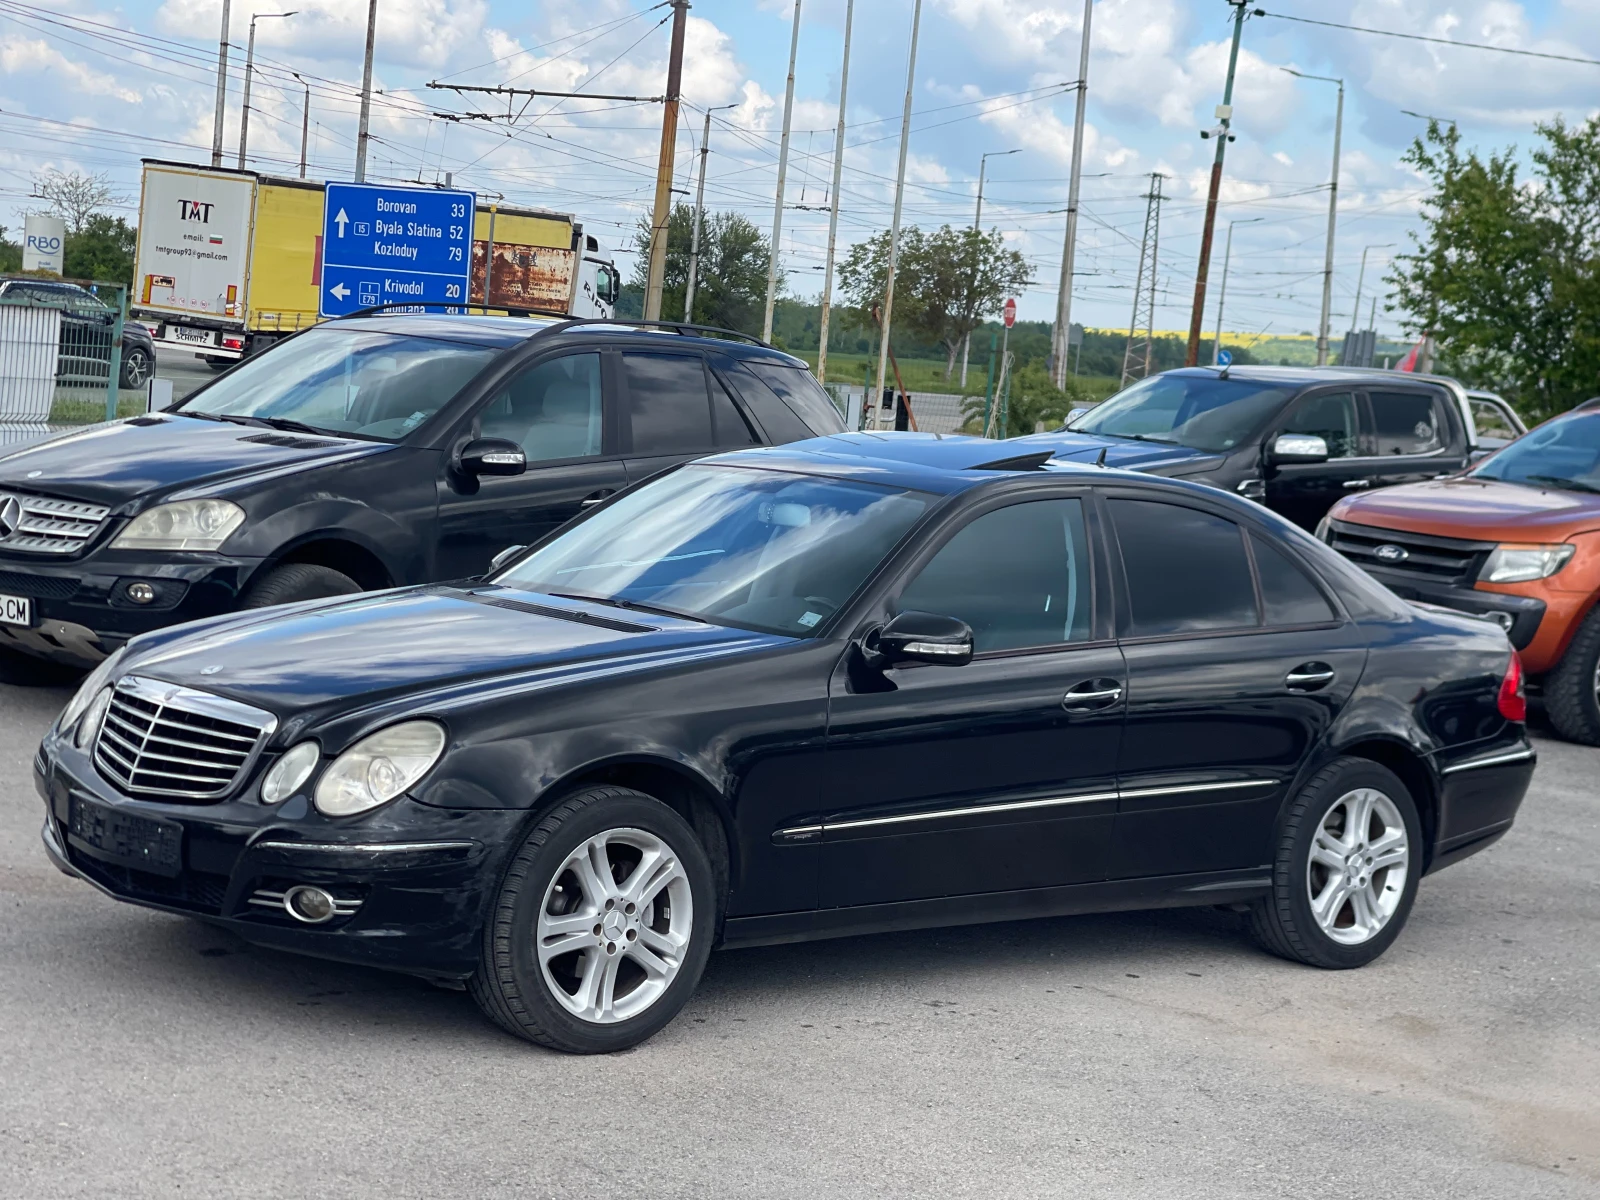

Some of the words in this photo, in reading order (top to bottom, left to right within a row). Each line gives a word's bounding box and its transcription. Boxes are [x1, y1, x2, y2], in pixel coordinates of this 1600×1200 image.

[177, 199, 215, 224] TMT
[377, 198, 417, 214] Borovan
[451, 203, 465, 218] 33
[183, 233, 204, 242] email:
[358, 225, 366, 233] 15
[375, 220, 403, 237] Byala
[407, 222, 442, 238] Slatina
[449, 225, 464, 240] 52
[27, 235, 60, 254] RBO
[374, 241, 418, 261] Kozloduy
[448, 247, 463, 262] 79
[384, 278, 424, 295] Krivodol
[445, 284, 460, 298] 20
[362, 295, 376, 304] E79
[176, 333, 207, 344] SCHMITZ
[7, 599, 26, 622] CM
